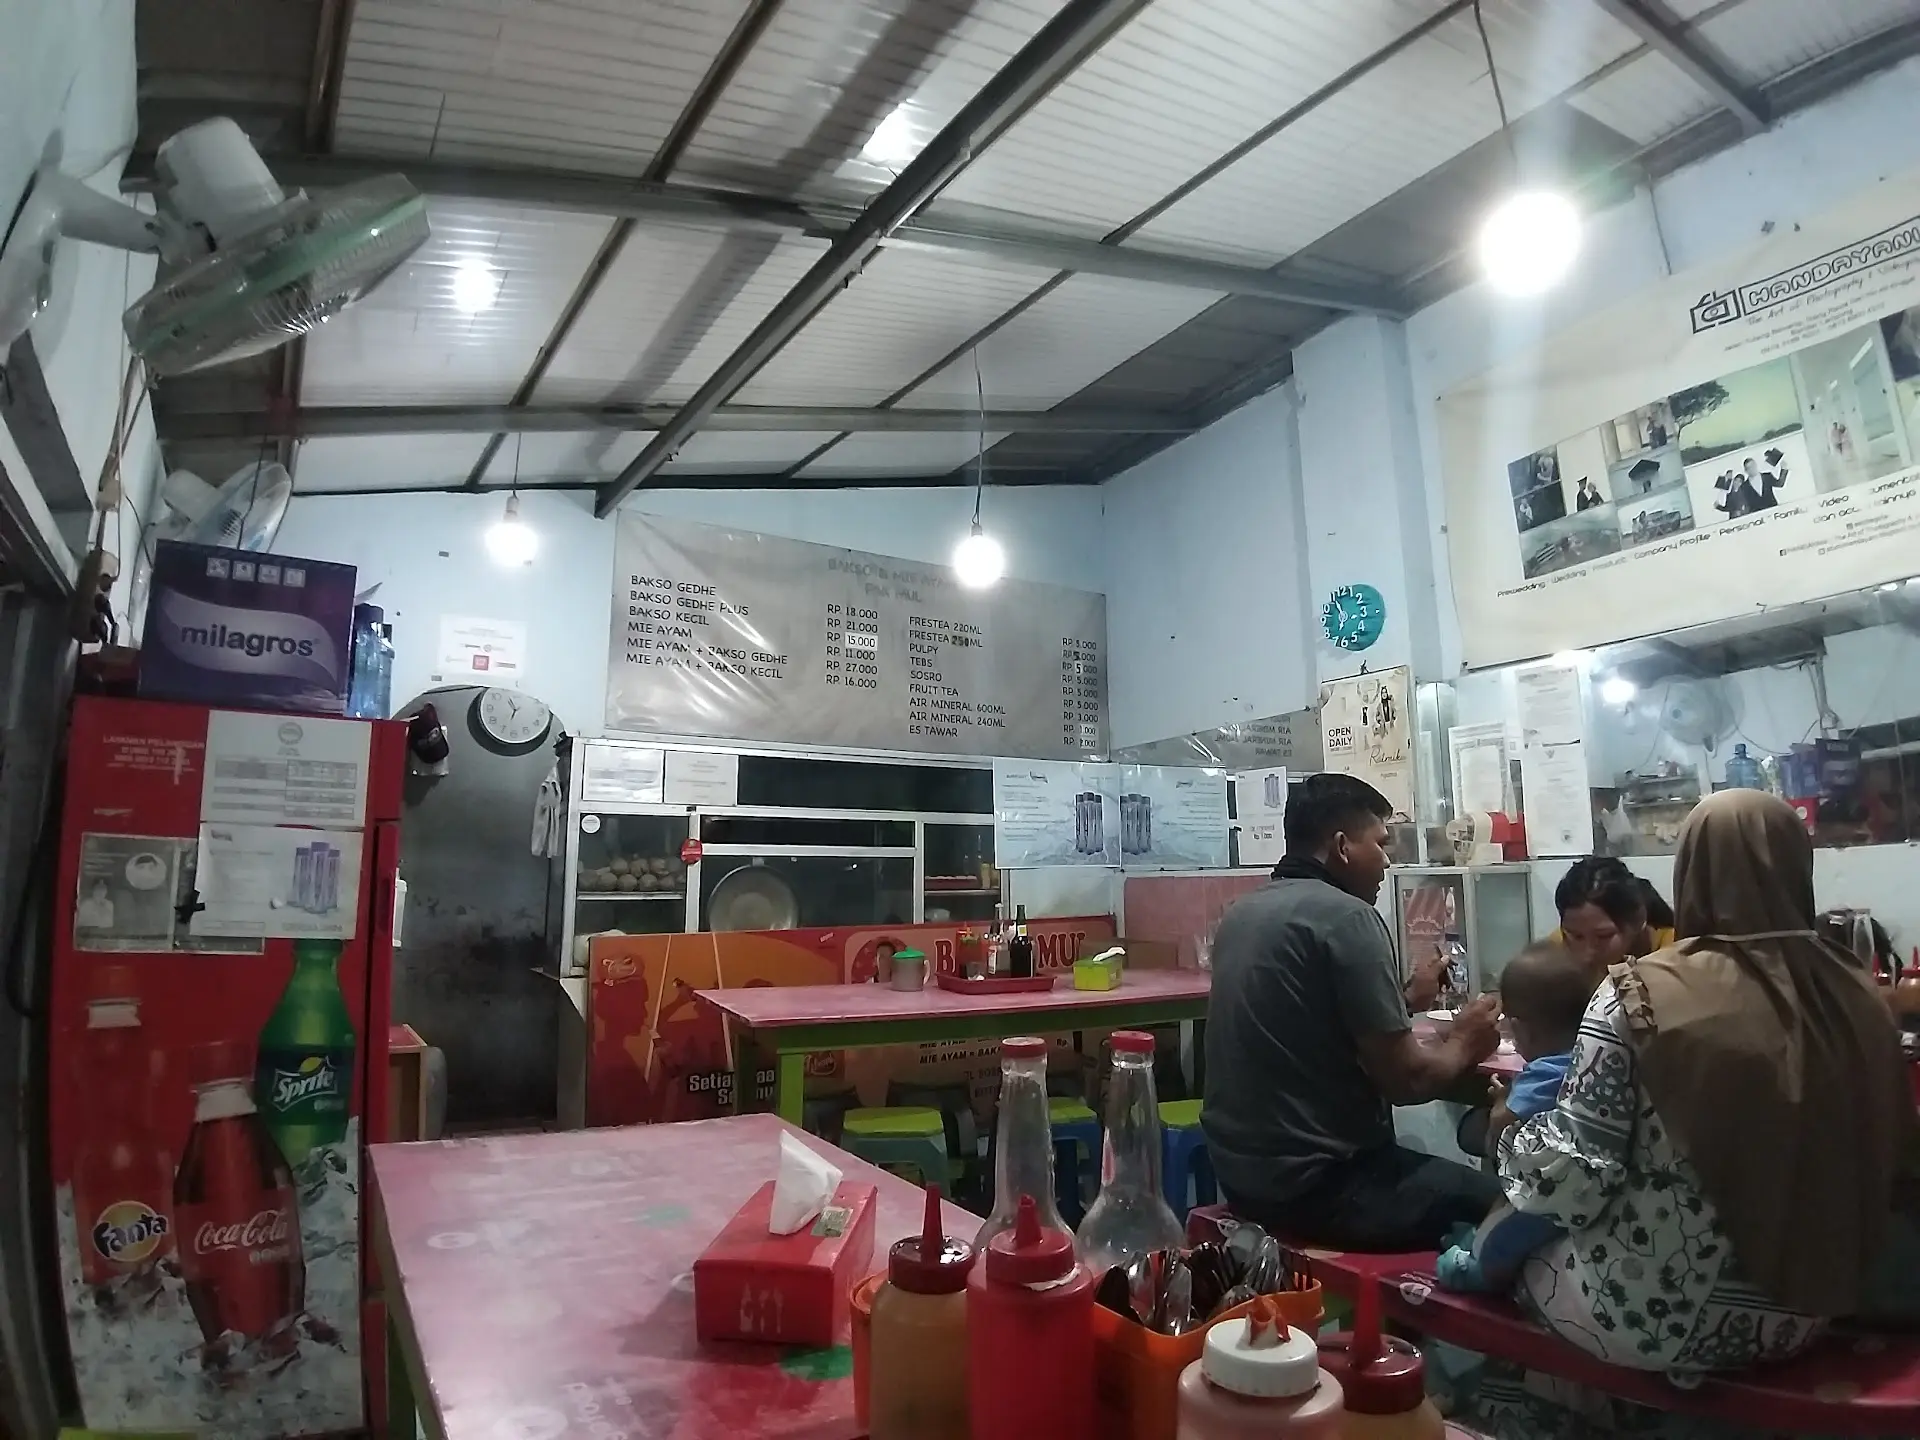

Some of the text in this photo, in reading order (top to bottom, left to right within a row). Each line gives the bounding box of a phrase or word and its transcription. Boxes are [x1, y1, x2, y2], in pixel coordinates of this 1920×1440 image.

[1719, 517, 1766, 536] Personal
[631, 575, 716, 595] BAKSO GEDHE
[1334, 586, 1347, 597] 12
[1348, 586, 1353, 597] 1
[630, 590, 671, 605] BAKSO
[676, 597, 715, 611] GEDHE
[1355, 593, 1363, 604] 2
[629, 605, 709, 626] BAKSO KECIL
[846, 607, 878, 619] 18.000
[1360, 606, 1367, 617] 3
[846, 621, 878, 633] 21.000
[909, 616, 982, 635] FRESTEA 220ML
[1320, 616, 1327, 627] 9
[1357, 620, 1365, 631] 4
[628, 622, 692, 638] MIE AYAM
[1324, 628, 1330, 639] 8
[181, 624, 313, 657] milagros
[909, 630, 949, 643] FRESTEA
[1332, 636, 1339, 647] 7
[1341, 636, 1348, 647] 6
[1351, 631, 1357, 642] 5
[627, 637, 652, 649] MIE
[656, 641, 690, 653] AYAM
[696, 647, 702, 655] +
[751, 652, 788, 665] GEDHE
[846, 648, 875, 660] 11.000
[909, 643, 938, 655] PULPY
[626, 653, 651, 665] MIE
[750, 667, 783, 679] KECIL
[910, 656, 933, 667] TEBS
[846, 663, 878, 674] 27.000
[910, 670, 942, 682] SOSRO
[845, 677, 877, 688] 16.000
[909, 684, 959, 697] FRUIT TEA
[910, 697, 1006, 715] AIR MINERAL 600ML
[910, 711, 1006, 728] AIR MINERAL 240ML
[910, 725, 958, 737] ES TAWAR
[1328, 726, 1351, 737] OPEN
[1329, 736, 1352, 748] DAILY
[919, 1053, 937, 1064] MIE
[941, 1050, 967, 1061] AYAM
[273, 1065, 334, 1104] Sprite
[94, 1213, 167, 1257] Fanta
[194, 1209, 288, 1254] Coca-Cola
